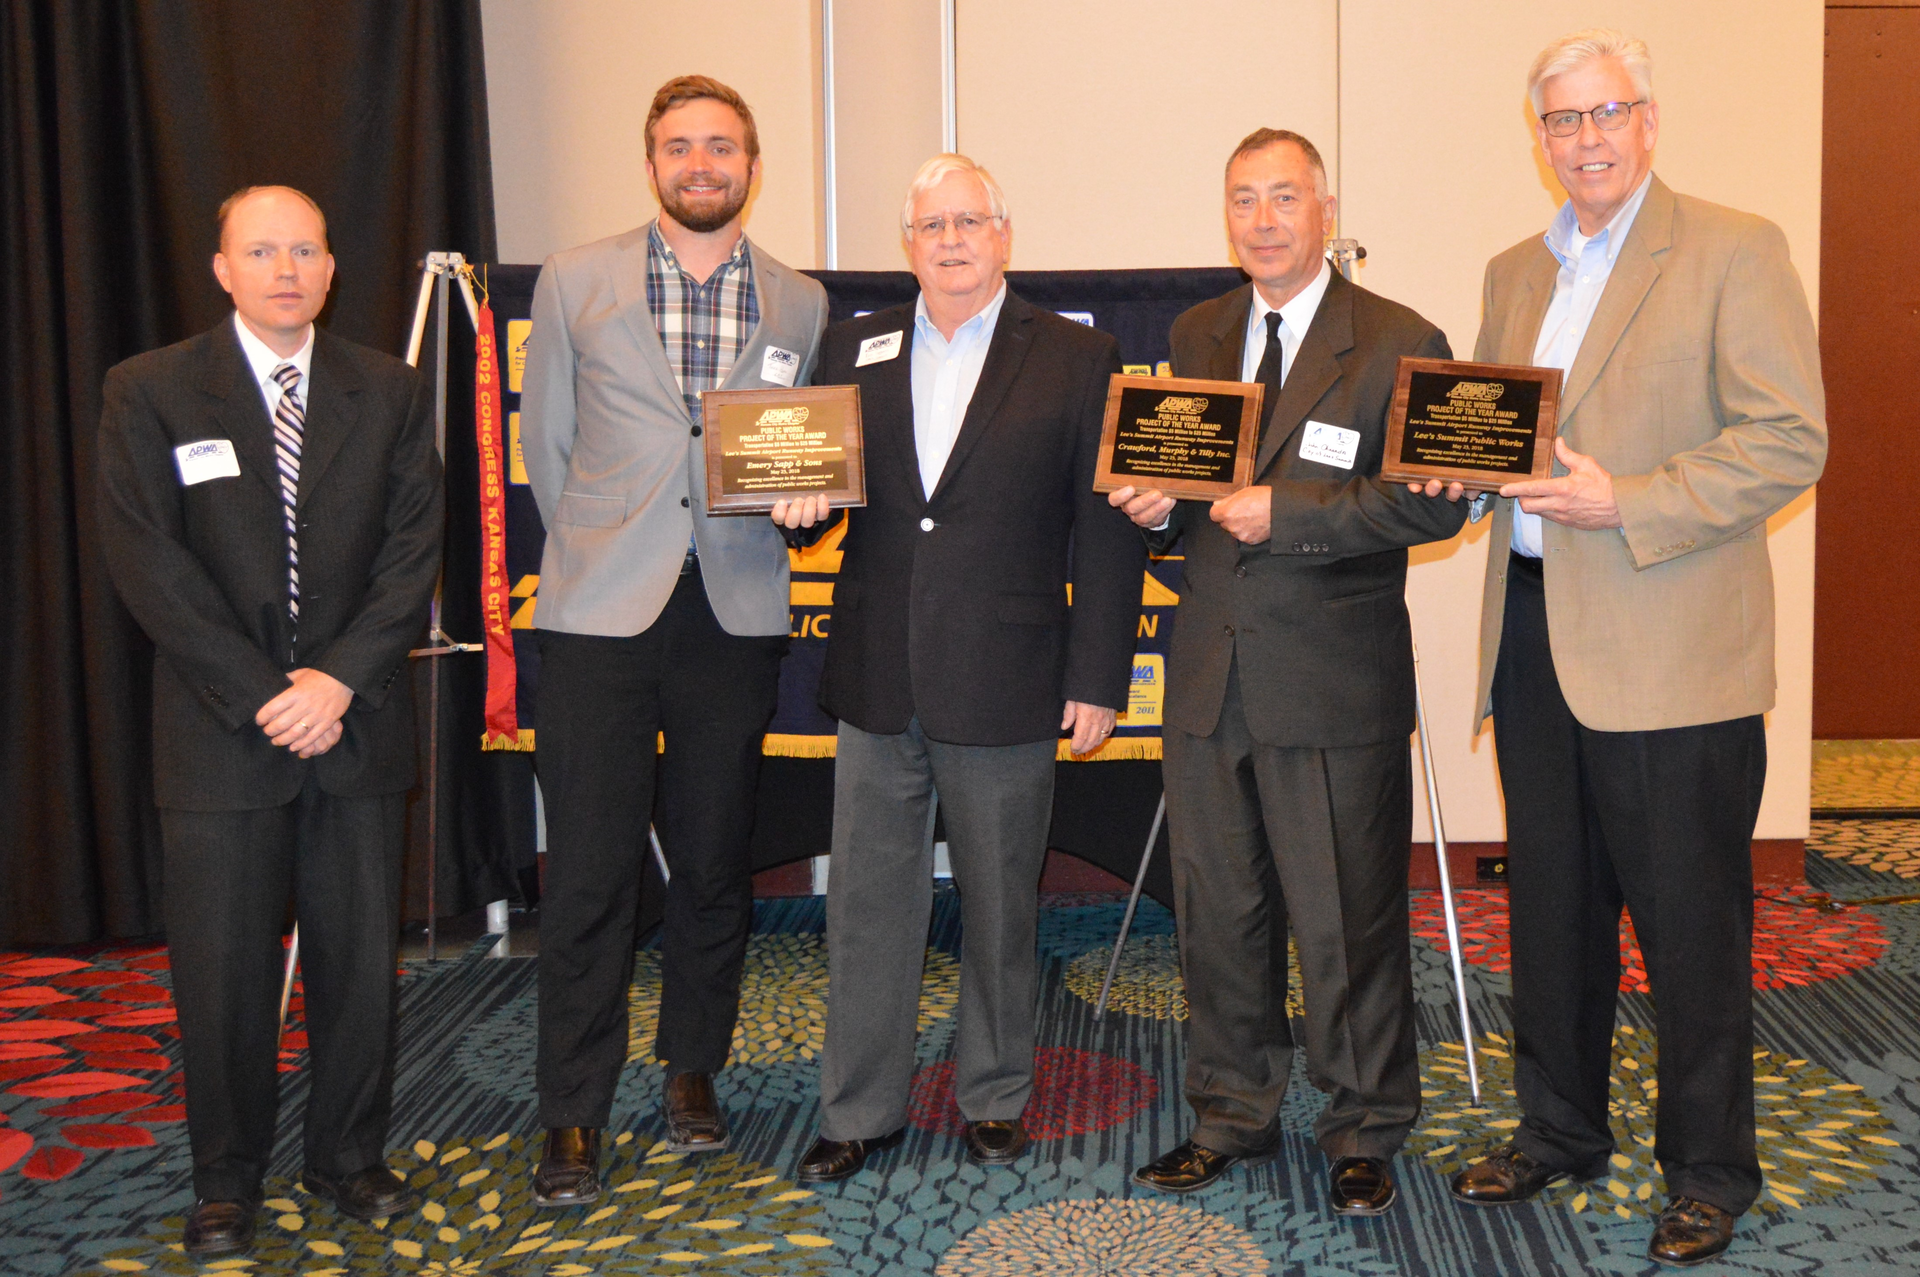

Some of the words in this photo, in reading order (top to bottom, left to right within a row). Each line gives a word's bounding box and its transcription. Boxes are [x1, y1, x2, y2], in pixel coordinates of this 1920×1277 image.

[480, 334, 491, 384] 2002
[1451, 381, 1487, 395] APWA
[1159, 396, 1193, 409] APWA
[1450, 400, 1473, 408] PUBLIC
[759, 408, 793, 421] APWA
[1158, 413, 1179, 421] PUBLIC
[1427, 405, 1454, 414] PROJECT
[1477, 409, 1494, 417] YEAR
[1495, 410, 1518, 419] AWARD
[1199, 423, 1221, 431] AWARD
[480, 391, 500, 498] CONGRESS
[1414, 431, 1435, 440] Lee's
[1436, 433, 1469, 443] Summit
[1470, 436, 1497, 445] Public
[1498, 438, 1524, 447] Works
[188, 443, 218, 457] APWA
[1118, 443, 1157, 453] Crawford,
[1159, 447, 1189, 456] Murphy
[1199, 449, 1216, 458] Tilly
[747, 462, 772, 470] Emery
[774, 461, 794, 469] Sapp
[488, 507, 501, 588] KANSAS
[488, 592, 505, 636] CITY
[1136, 706, 1156, 715] 2011
